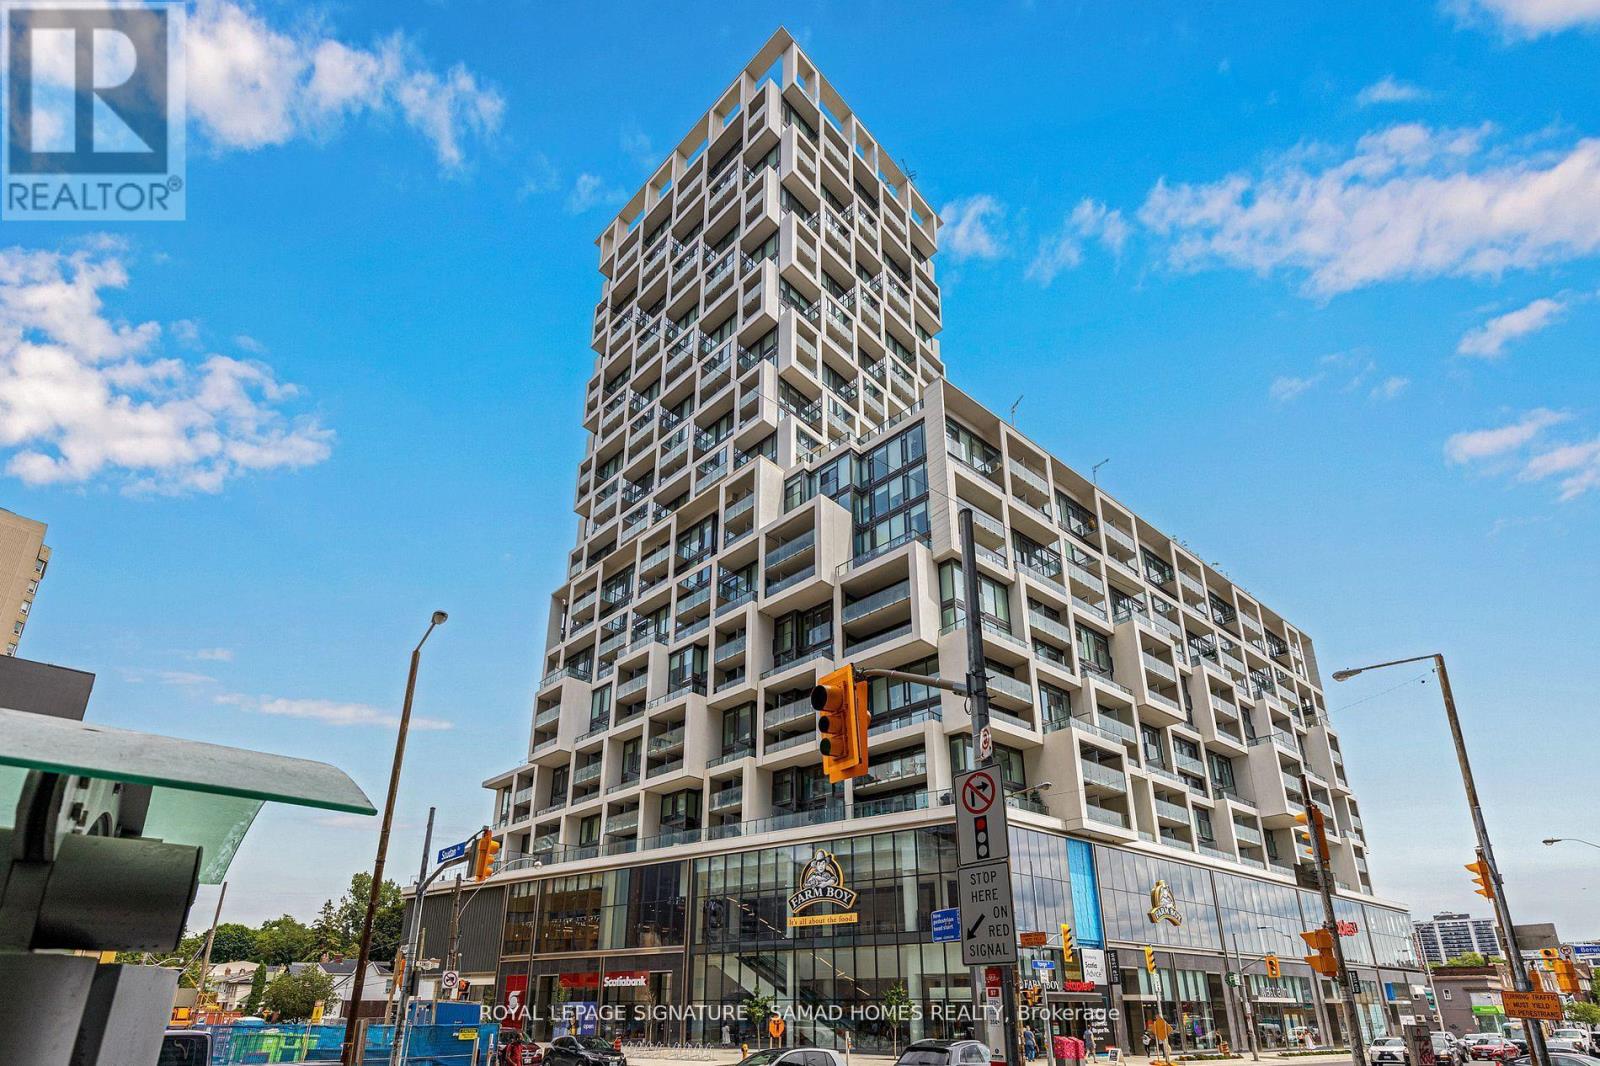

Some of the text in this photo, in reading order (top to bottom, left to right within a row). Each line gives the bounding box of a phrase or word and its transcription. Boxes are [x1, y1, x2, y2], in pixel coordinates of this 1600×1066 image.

[970, 870, 997, 885] STOP
[791, 887, 852, 907] FARM BOY
[971, 888, 999, 903] HERE
[993, 905, 1008, 919] ON
[989, 923, 1010, 937] RED
[970, 943, 1009, 957] SIGNAL
[604, 975, 646, 987] Scotiabank
